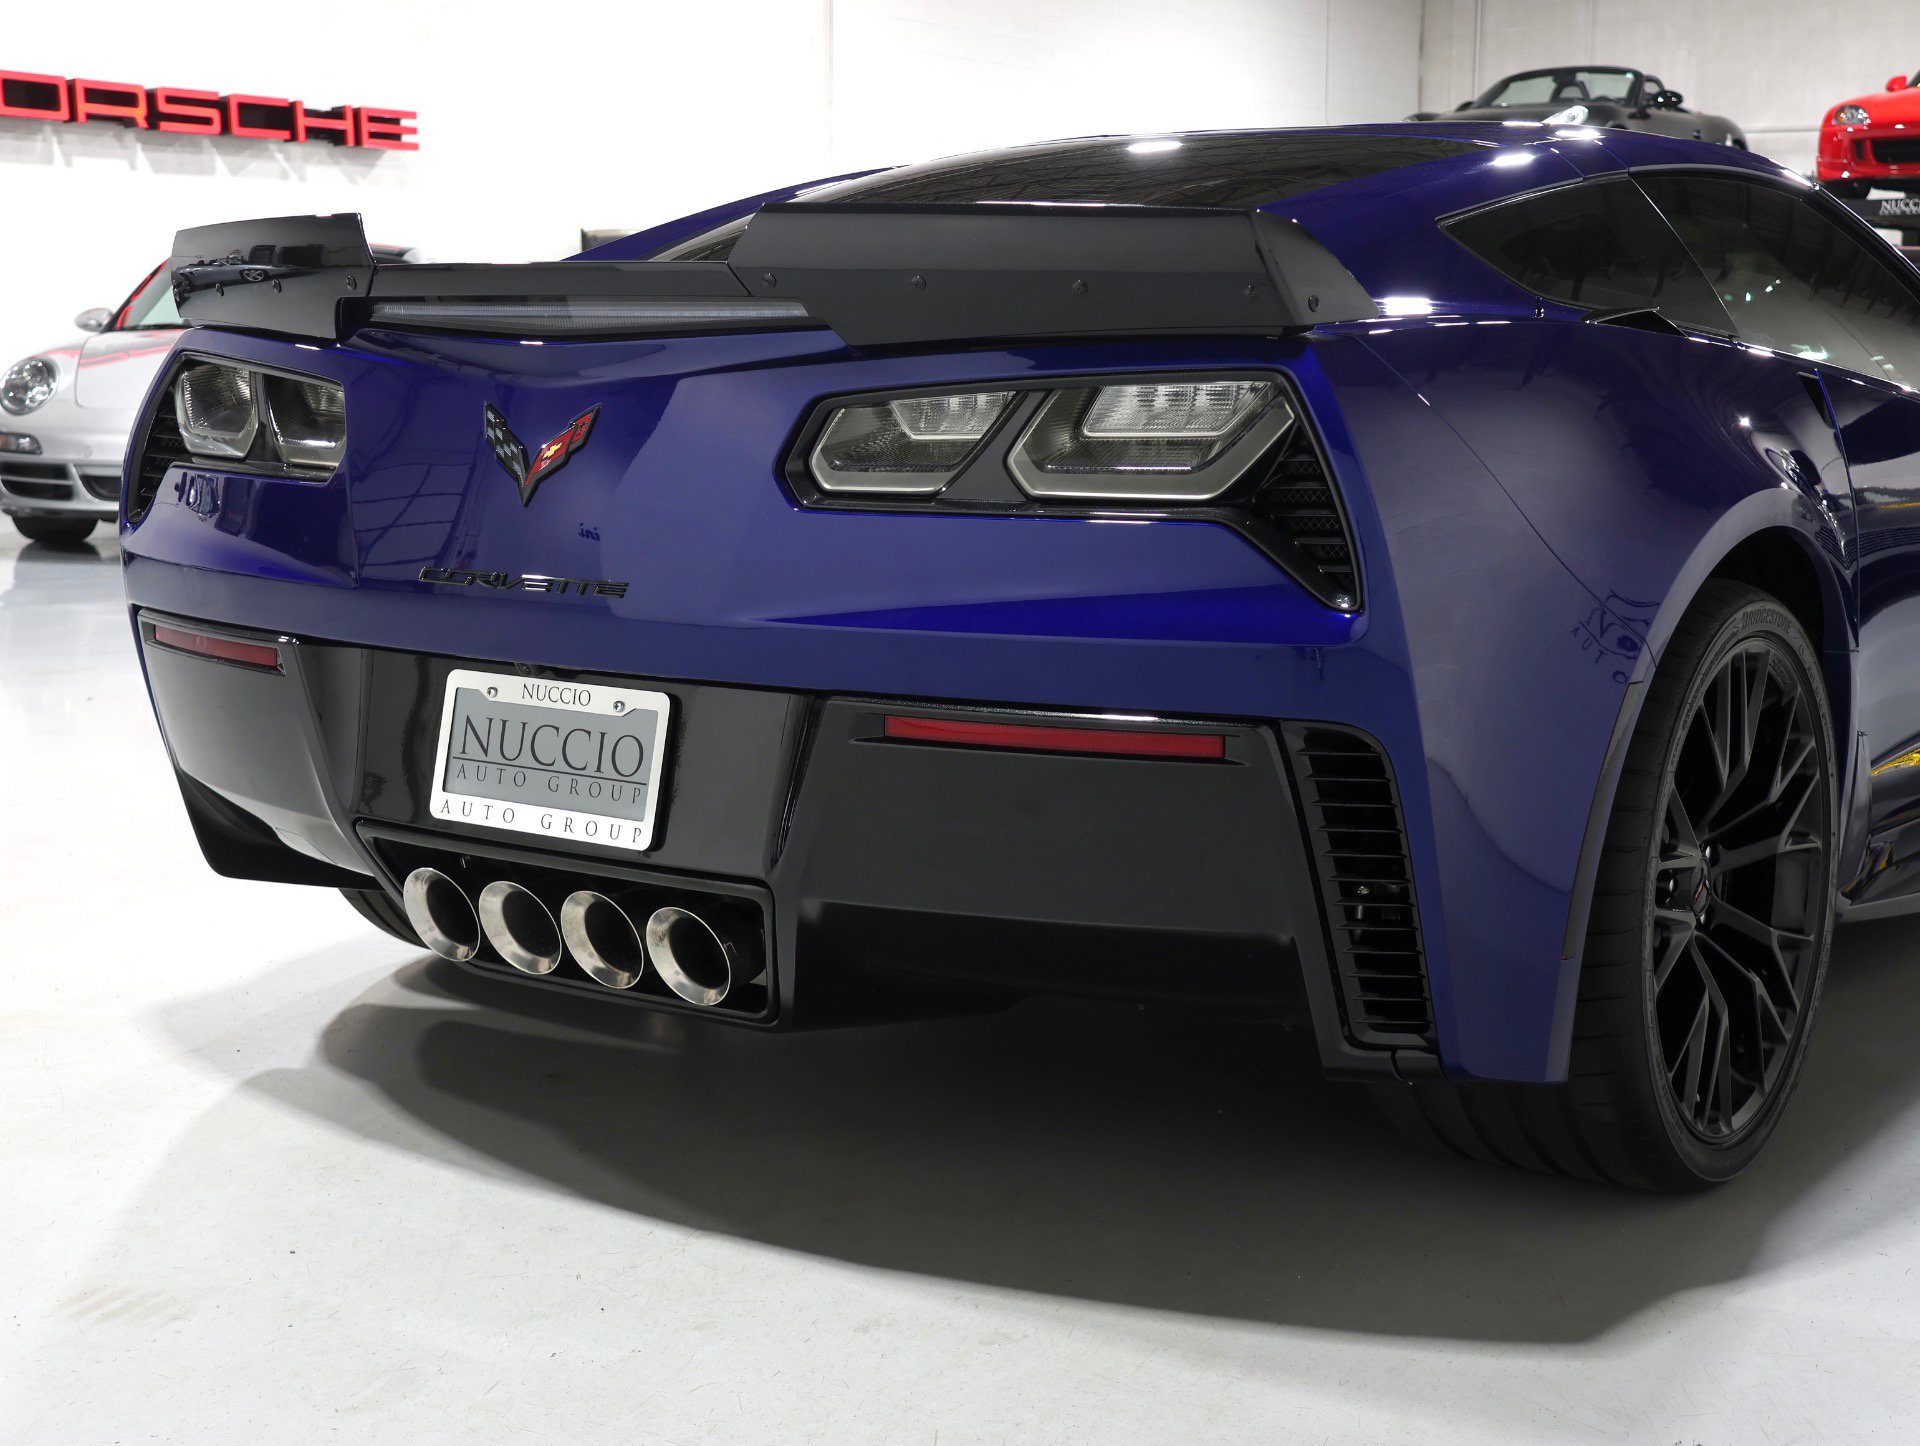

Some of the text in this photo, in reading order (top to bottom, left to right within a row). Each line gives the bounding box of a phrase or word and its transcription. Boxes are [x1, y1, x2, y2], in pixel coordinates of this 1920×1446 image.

[419, 567, 630, 599] CORVETTE
[1741, 608, 1792, 635] BRIDGESTONE
[521, 683, 591, 707] NUCCIO
[459, 714, 644, 778] NUCCIO
[456, 763, 642, 804] AUTO GROUP
[440, 798, 643, 844] AUTO GROUP
